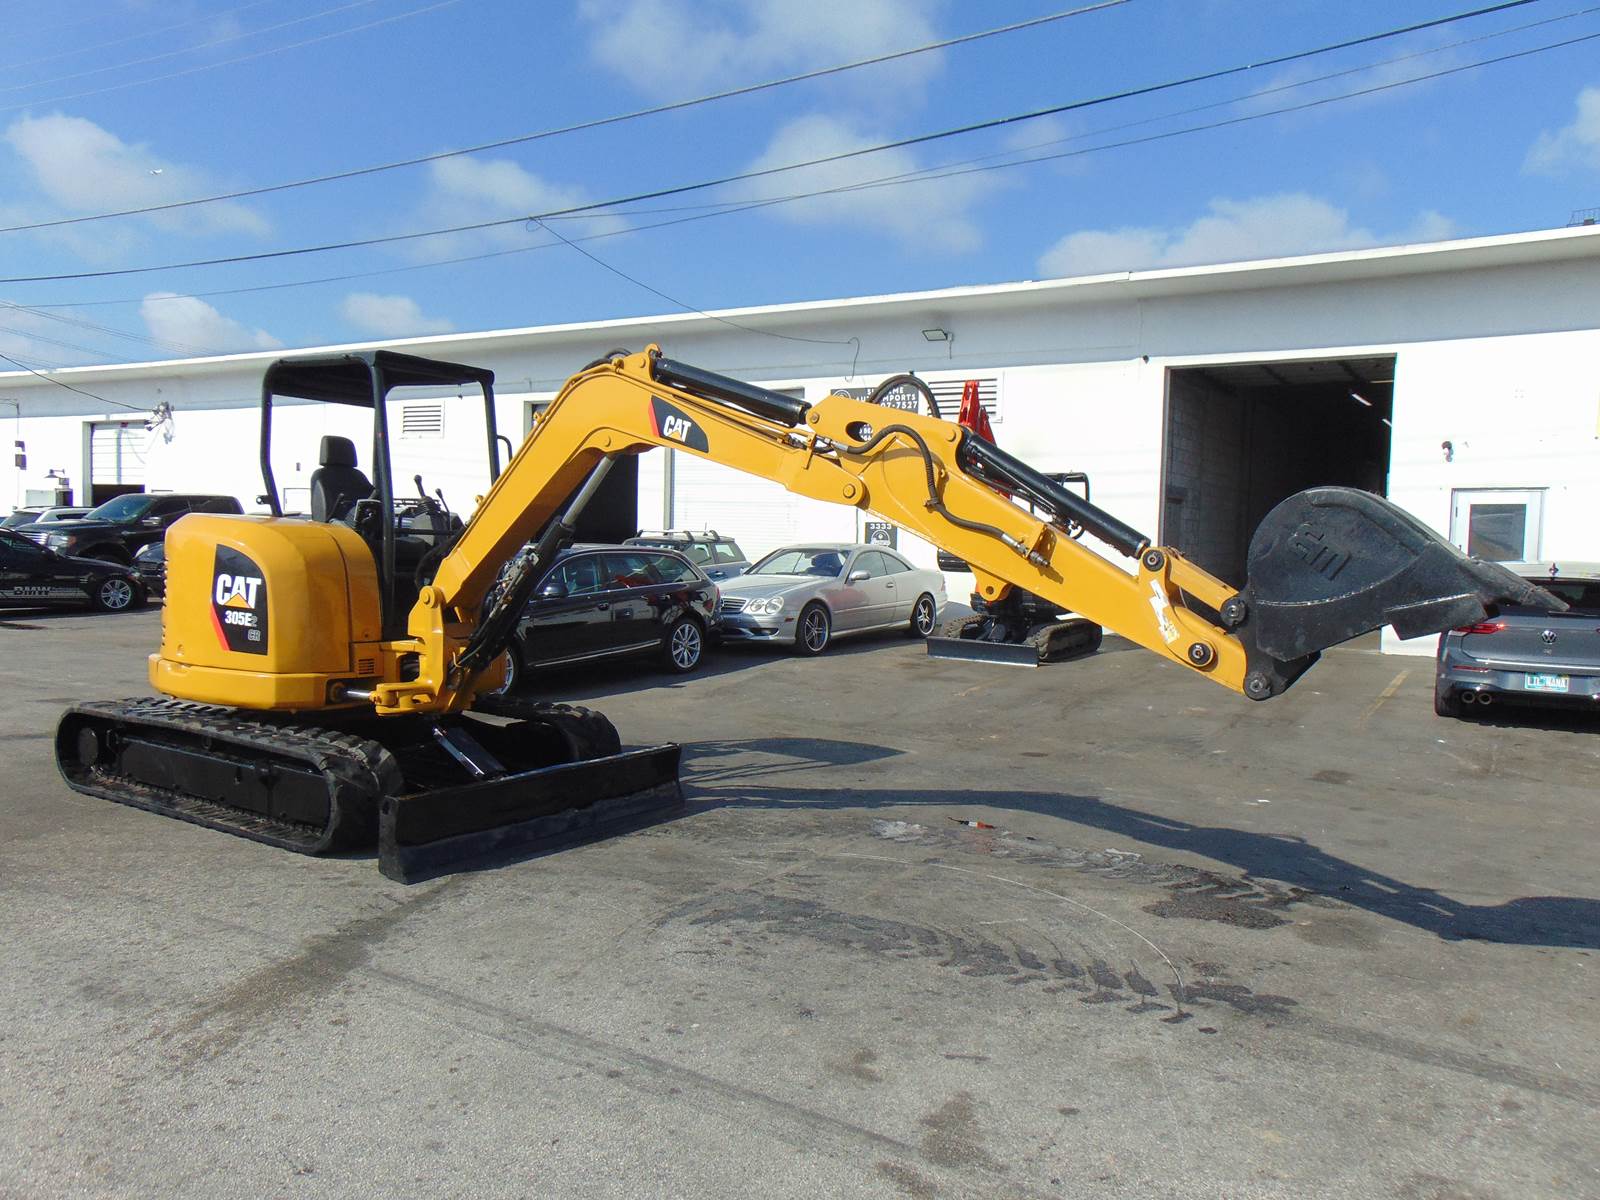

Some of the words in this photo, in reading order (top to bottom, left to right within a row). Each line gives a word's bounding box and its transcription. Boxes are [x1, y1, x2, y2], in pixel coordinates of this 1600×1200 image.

[882, 393, 916, 402] MPORTS
[663, 415, 692, 443] CAT
[14, 586, 51, 595] BMW
[215, 573, 263, 609] CAT
